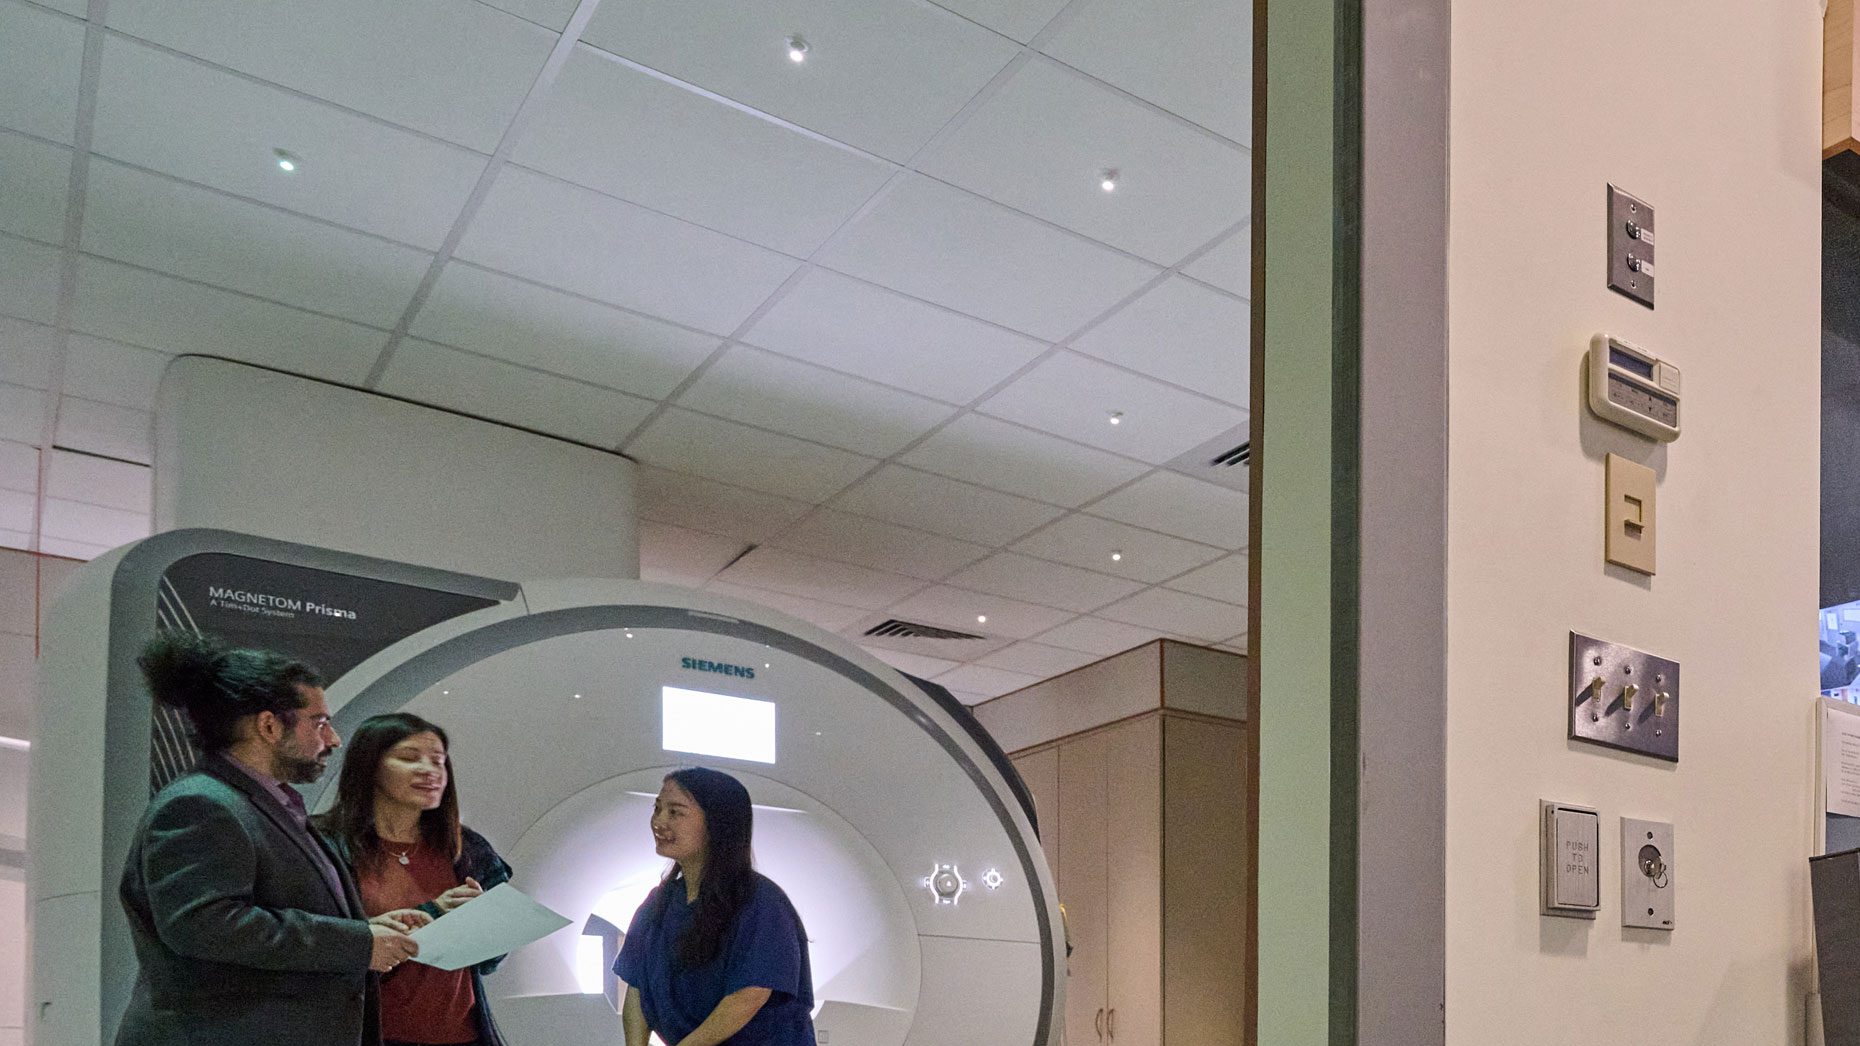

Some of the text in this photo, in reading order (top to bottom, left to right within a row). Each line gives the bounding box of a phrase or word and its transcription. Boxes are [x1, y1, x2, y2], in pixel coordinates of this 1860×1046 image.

[209, 586, 357, 620] MAGNETOM Prisma
[681, 657, 755, 679] SIEMENS
[1566, 841, 1589, 852] PUSH
[1566, 864, 1589, 875] OPEN
